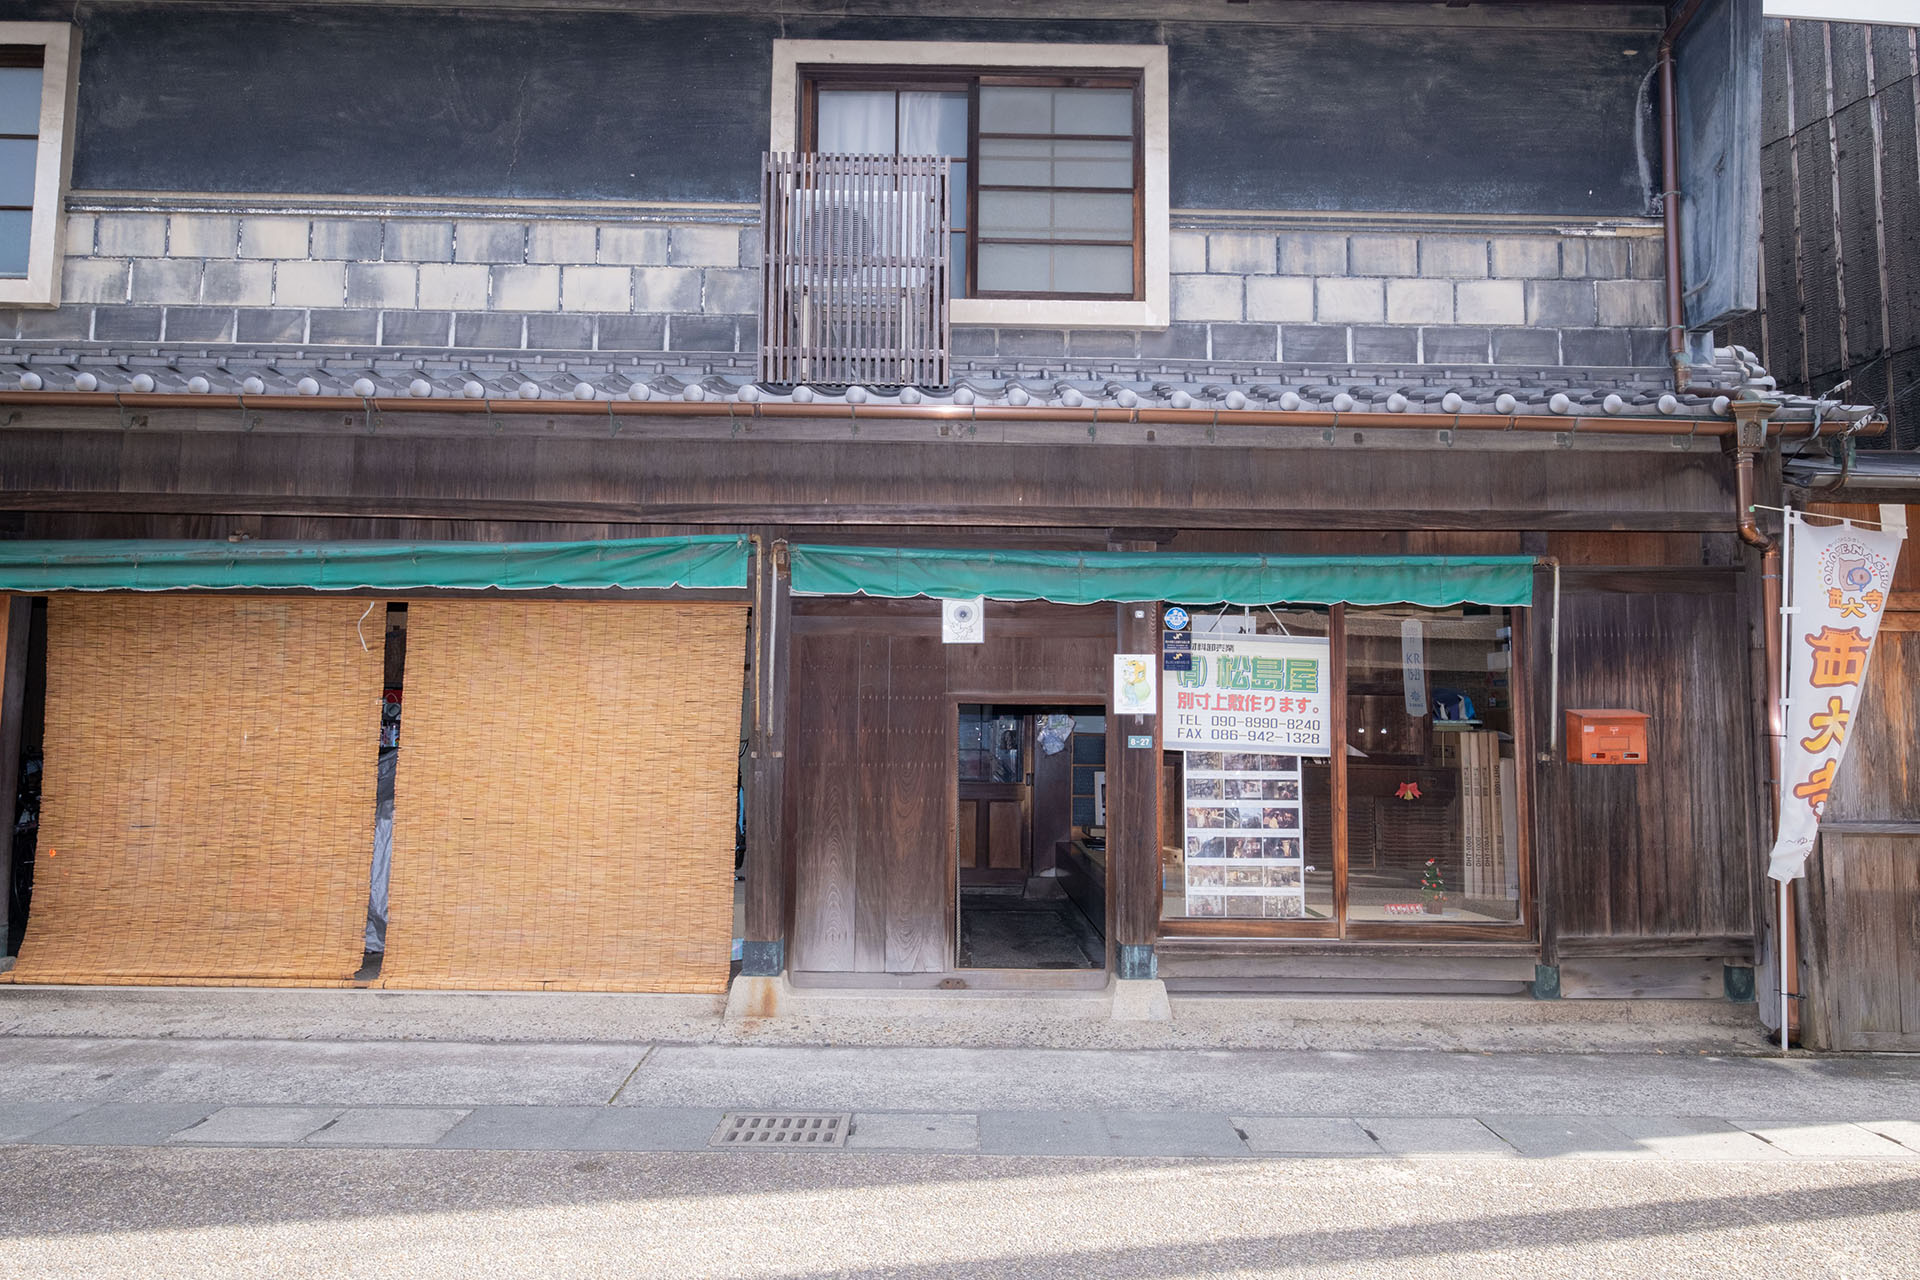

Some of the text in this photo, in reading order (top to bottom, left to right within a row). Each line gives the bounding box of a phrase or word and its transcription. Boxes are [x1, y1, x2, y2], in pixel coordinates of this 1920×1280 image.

[1827, 587, 1883, 618] 西大寺
[1177, 691, 1319, 714] 別寸上敷作ります。
[1178, 714, 1321, 731] TEL 090-8990-8240
[1130, 738, 1150, 747] 8-27
[1177, 728, 1321, 745] FAX 086-942-1328
